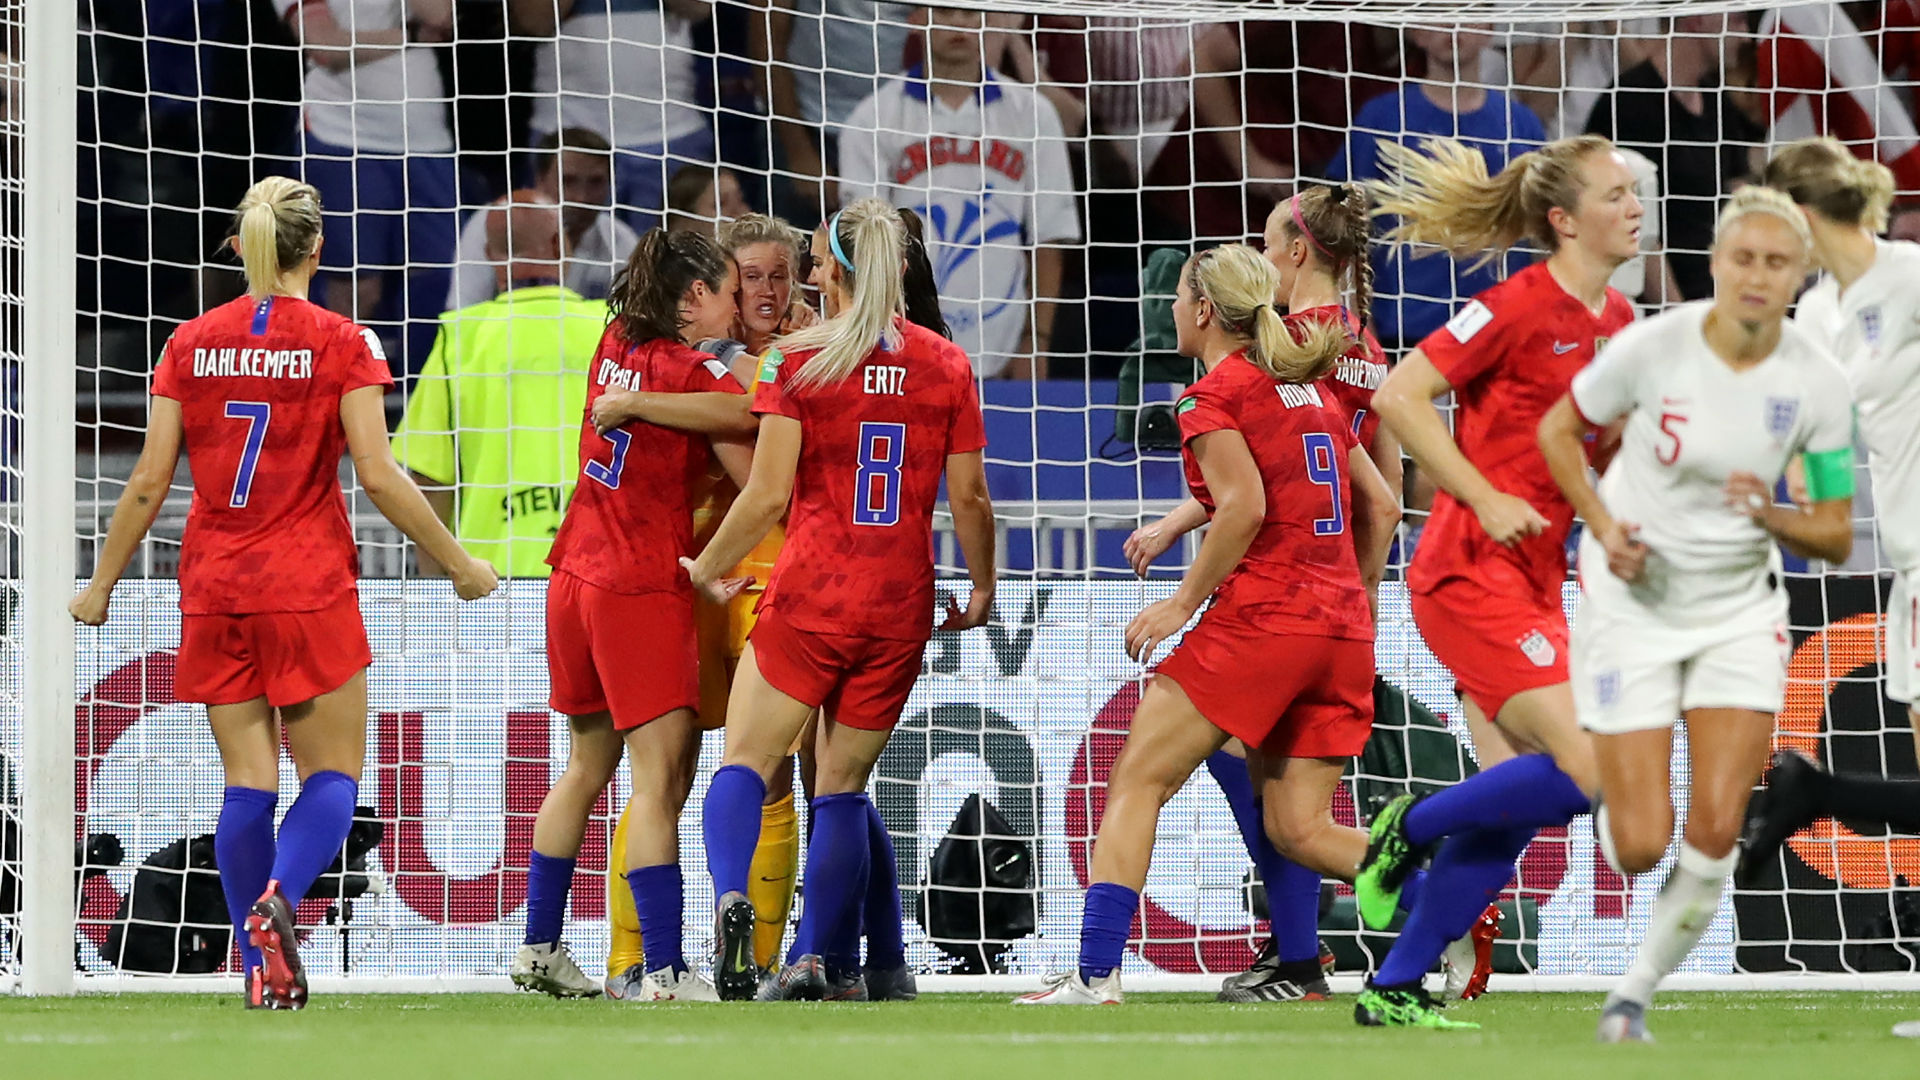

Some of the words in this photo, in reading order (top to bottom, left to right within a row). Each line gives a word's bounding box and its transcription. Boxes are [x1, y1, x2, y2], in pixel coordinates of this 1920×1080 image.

[193, 348, 313, 379] DAHLKEMPER
[863, 365, 907, 396] ERTZ
[224, 401, 270, 508] 7
[853, 421, 906, 526] 8
[1654, 413, 1689, 466] 5
[1302, 433, 1344, 536] 9
